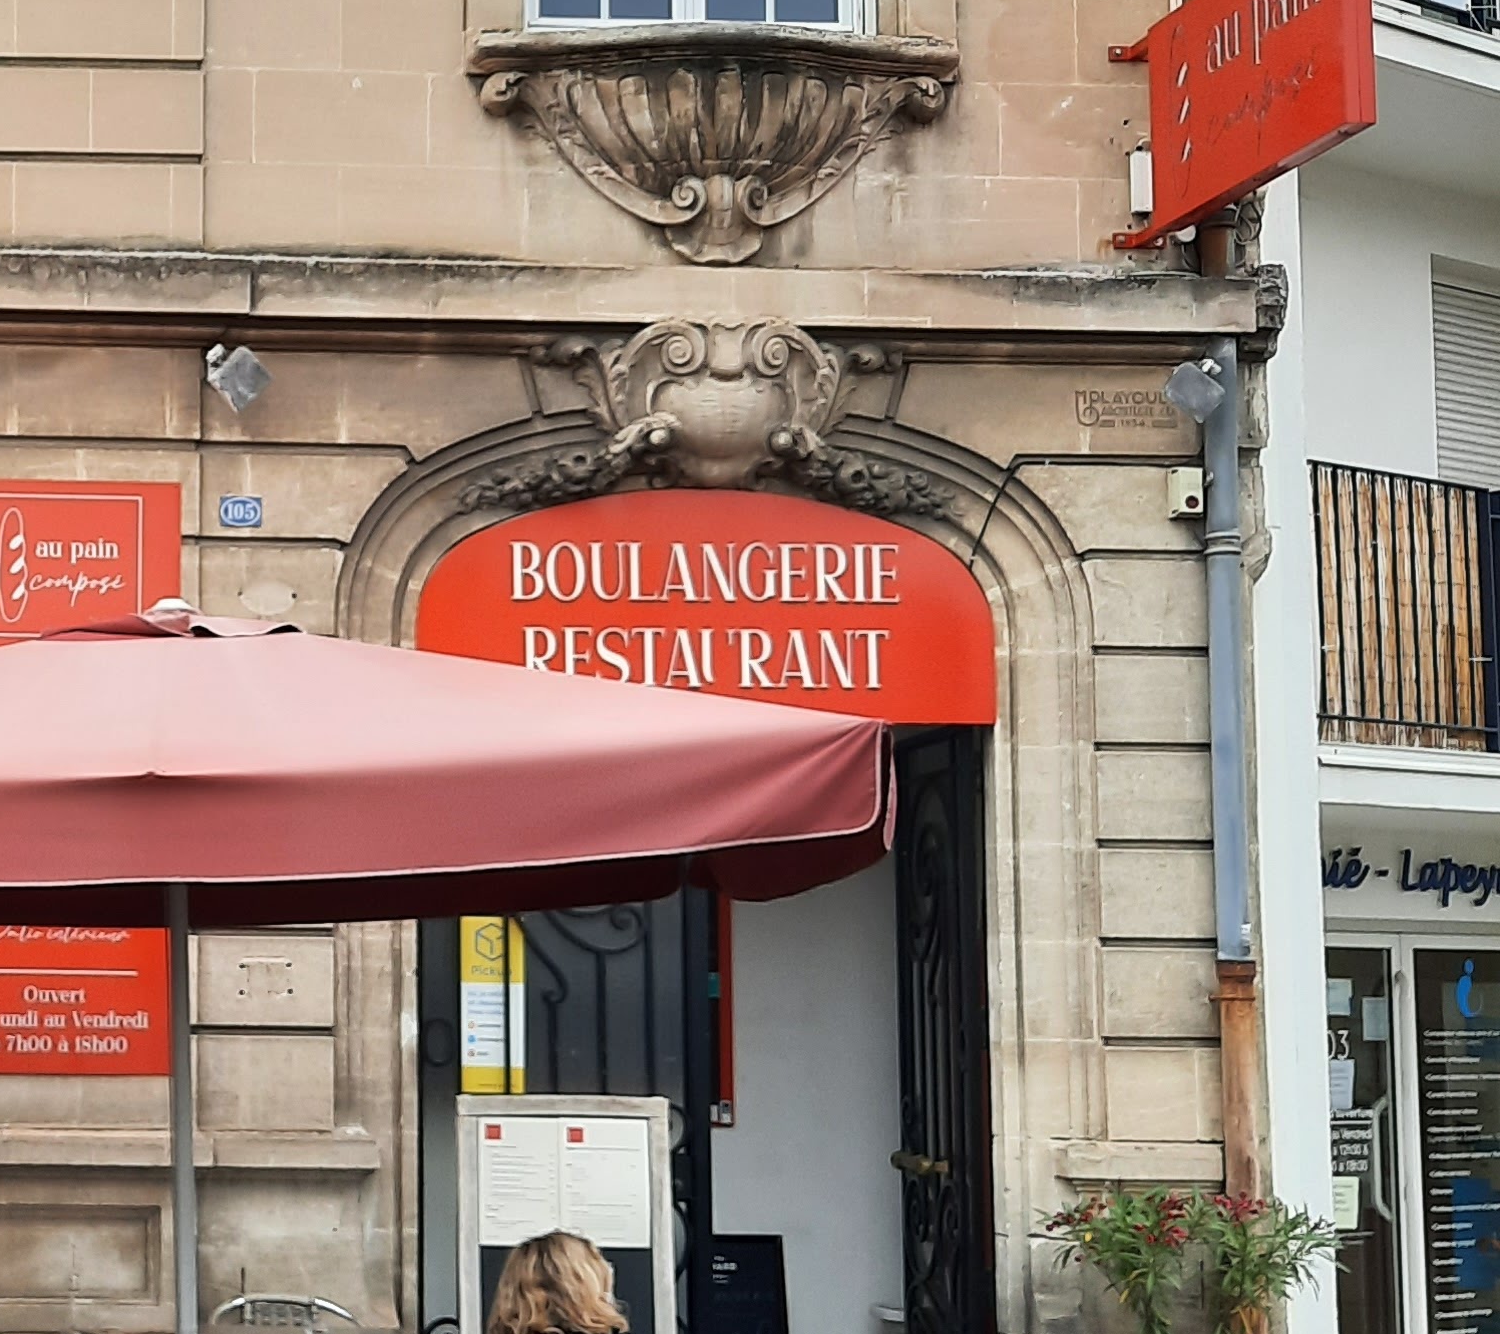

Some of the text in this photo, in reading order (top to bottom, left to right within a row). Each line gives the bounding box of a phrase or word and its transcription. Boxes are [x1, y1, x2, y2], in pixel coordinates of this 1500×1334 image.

[1205, 10, 1241, 73] au
[228, 502, 256, 520] 105
[35, 537, 119, 565] au pain
[509, 540, 900, 604] BOULANGERIE
[522, 626, 892, 689] RESTAURANT
[23, 985, 86, 1005] Ouvert
[44, 1013, 66, 1028] au
[72, 1010, 149, 1030] Vendredi
[5, 1034, 52, 1053] 7h00
[58, 1034, 70, 1053] à
[75, 1035, 129, 1054] 18h00
